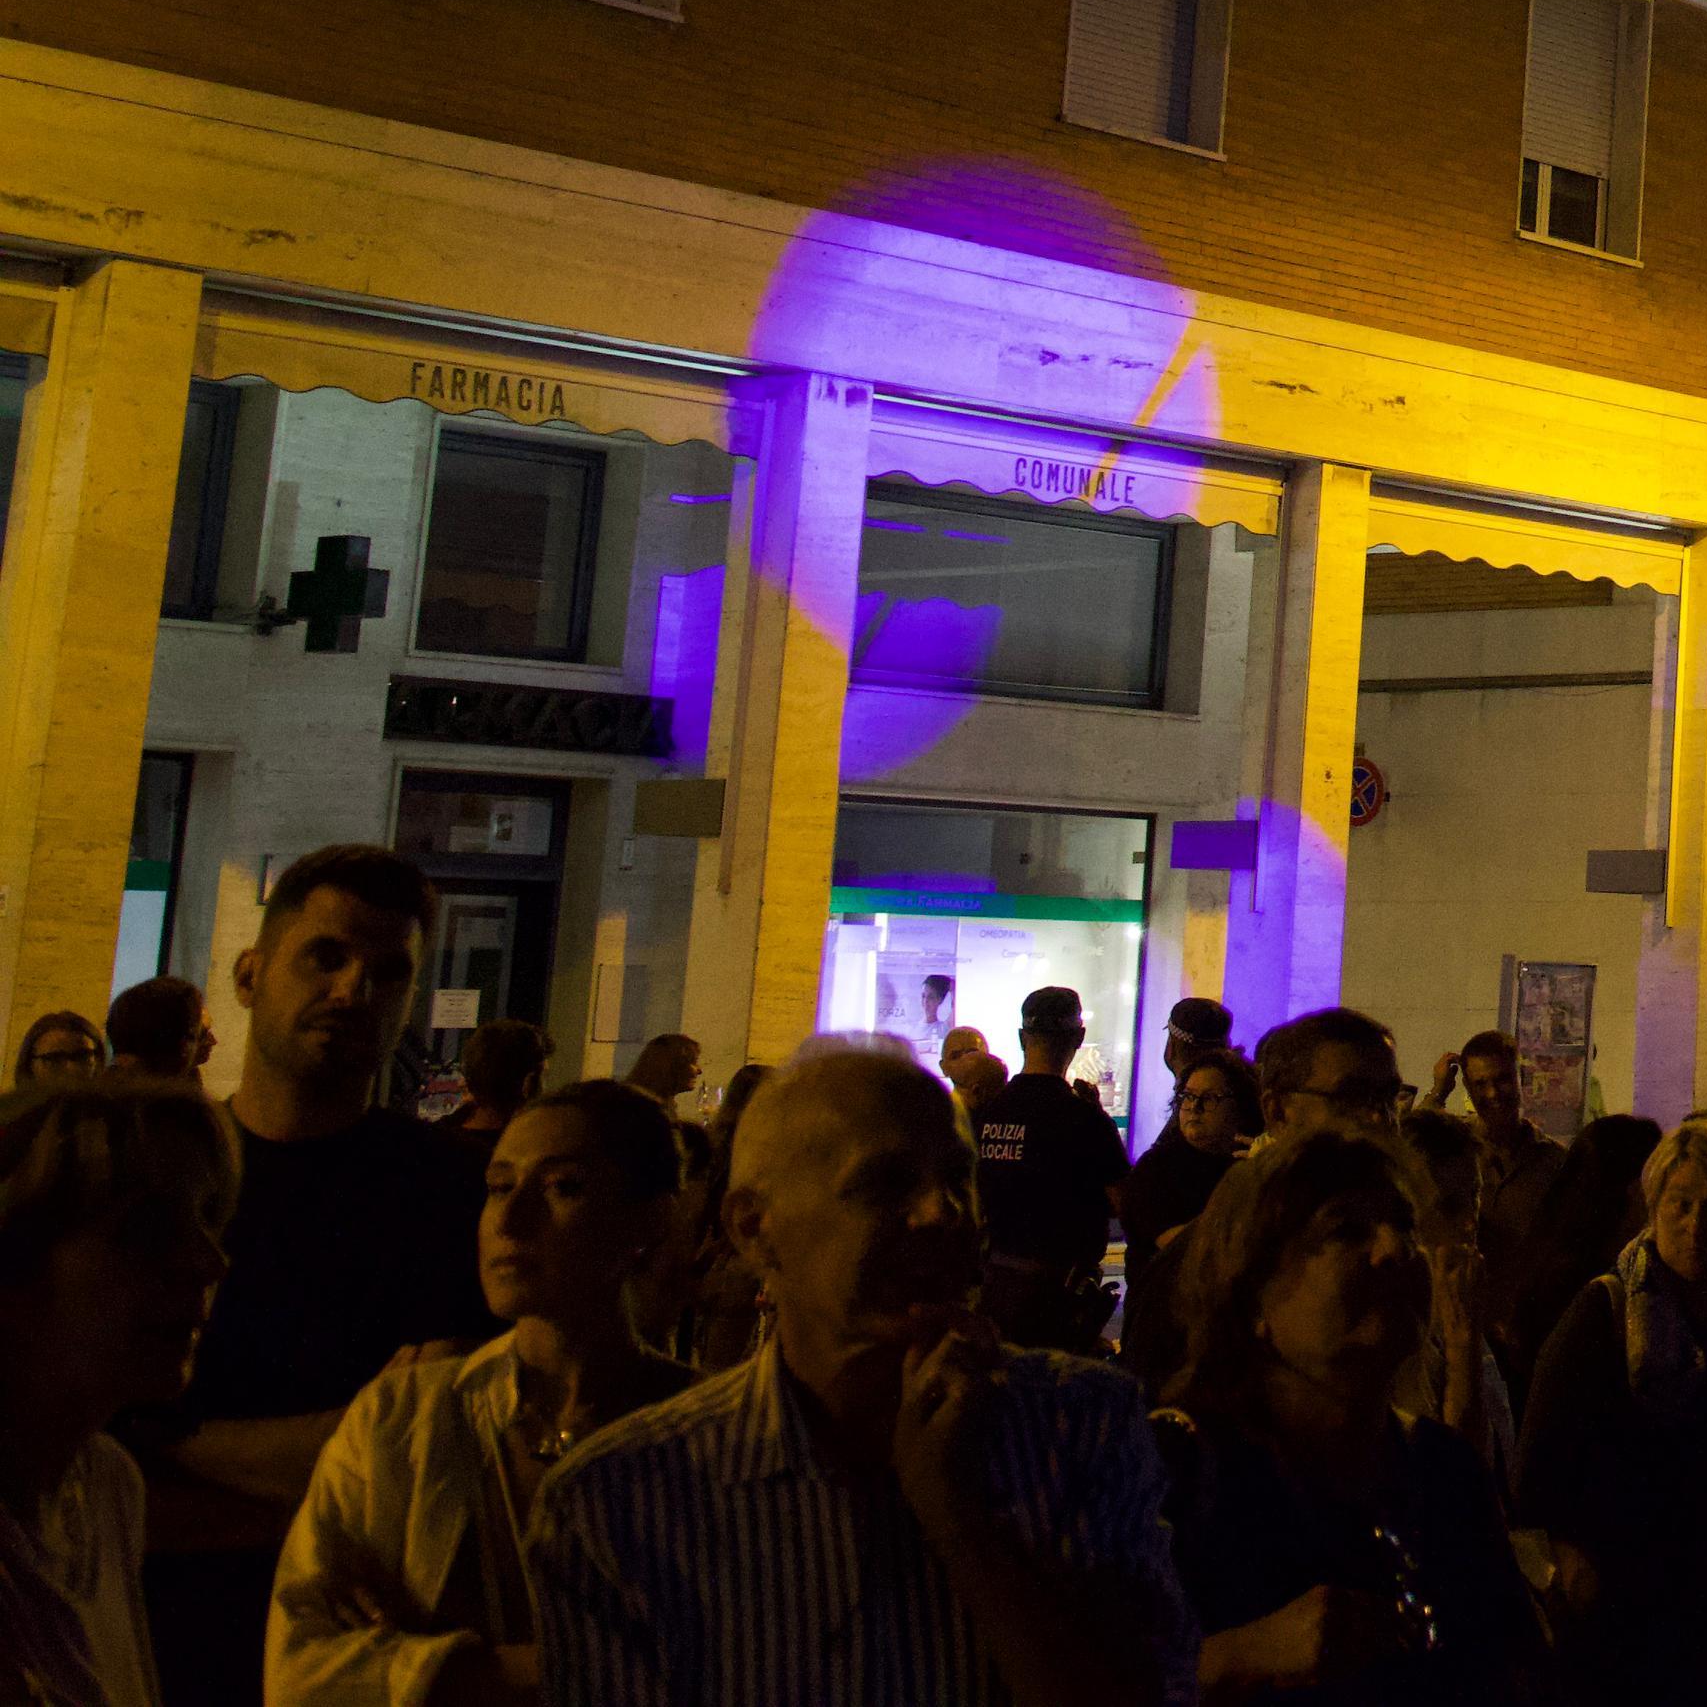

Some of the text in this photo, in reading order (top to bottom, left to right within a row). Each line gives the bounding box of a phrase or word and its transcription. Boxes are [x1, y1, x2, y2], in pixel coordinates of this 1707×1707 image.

[410, 361, 566, 417] FARMACIA
[1015, 457, 1136, 505] COMUNALE
[981, 1123, 1026, 1141] POLIZIA
[981, 1142, 1025, 1161] LOCALE
